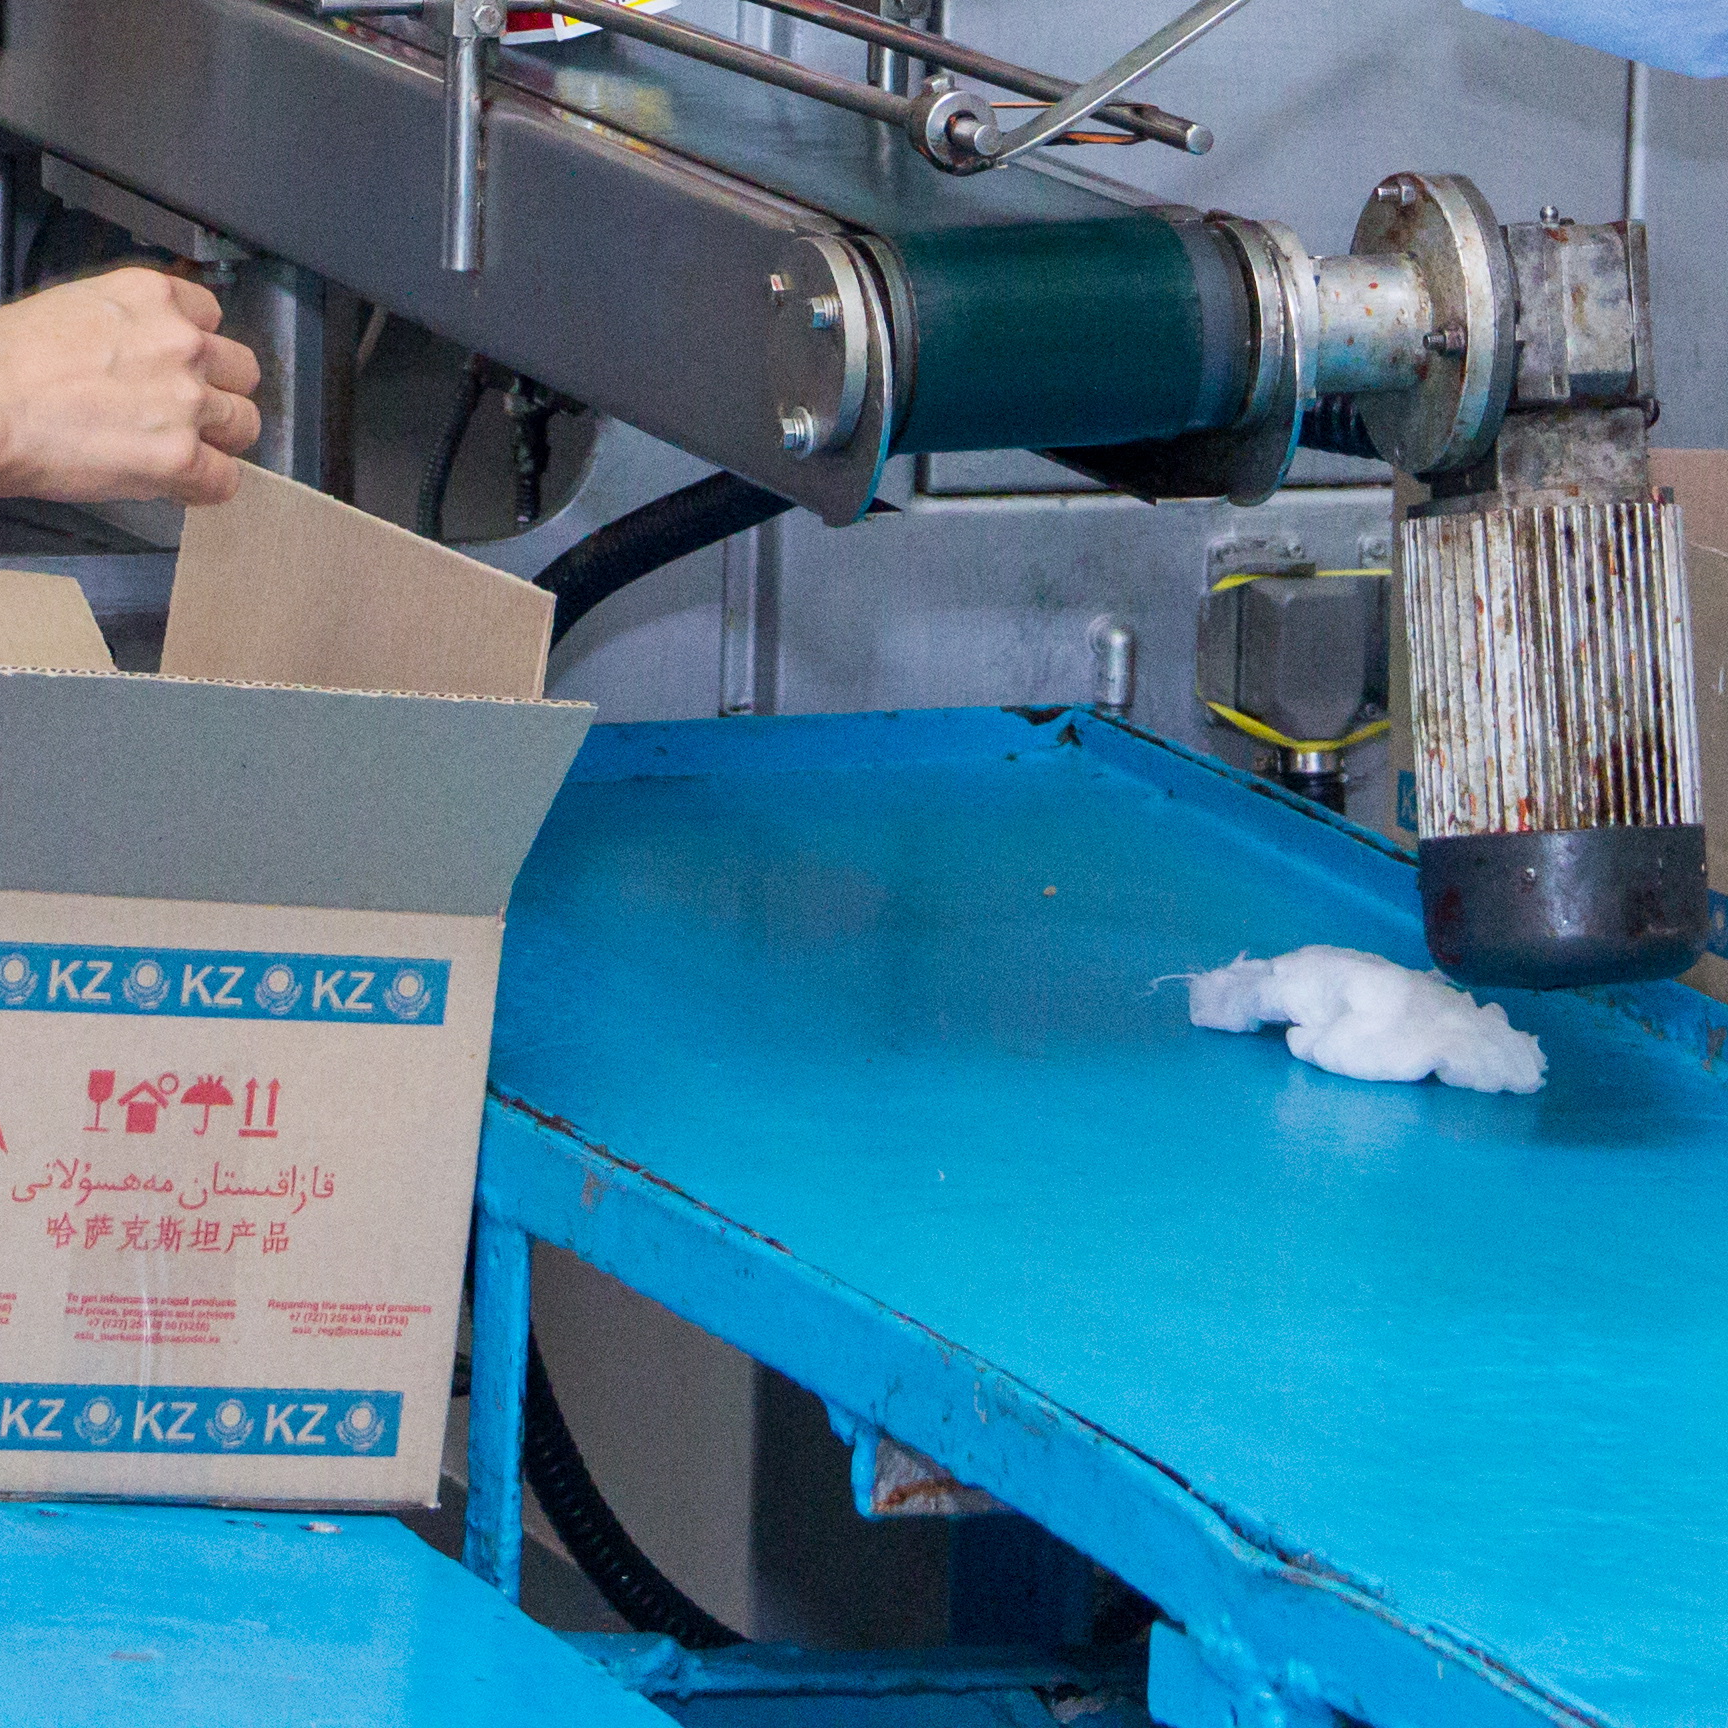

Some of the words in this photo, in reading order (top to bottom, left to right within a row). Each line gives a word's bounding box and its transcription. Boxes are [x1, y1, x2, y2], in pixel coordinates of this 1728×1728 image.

[48, 959, 113, 1002] KZ
[181, 964, 245, 1006] KZ
[311, 969, 376, 1011] KZ
[45, 1211, 290, 1255] 哈萨克斯坦产品
[267, 1298, 319, 1312] Regarding
[0, 1398, 66, 1441] KZ
[131, 1400, 198, 1443] KZ
[263, 1402, 328, 1446] KZ
